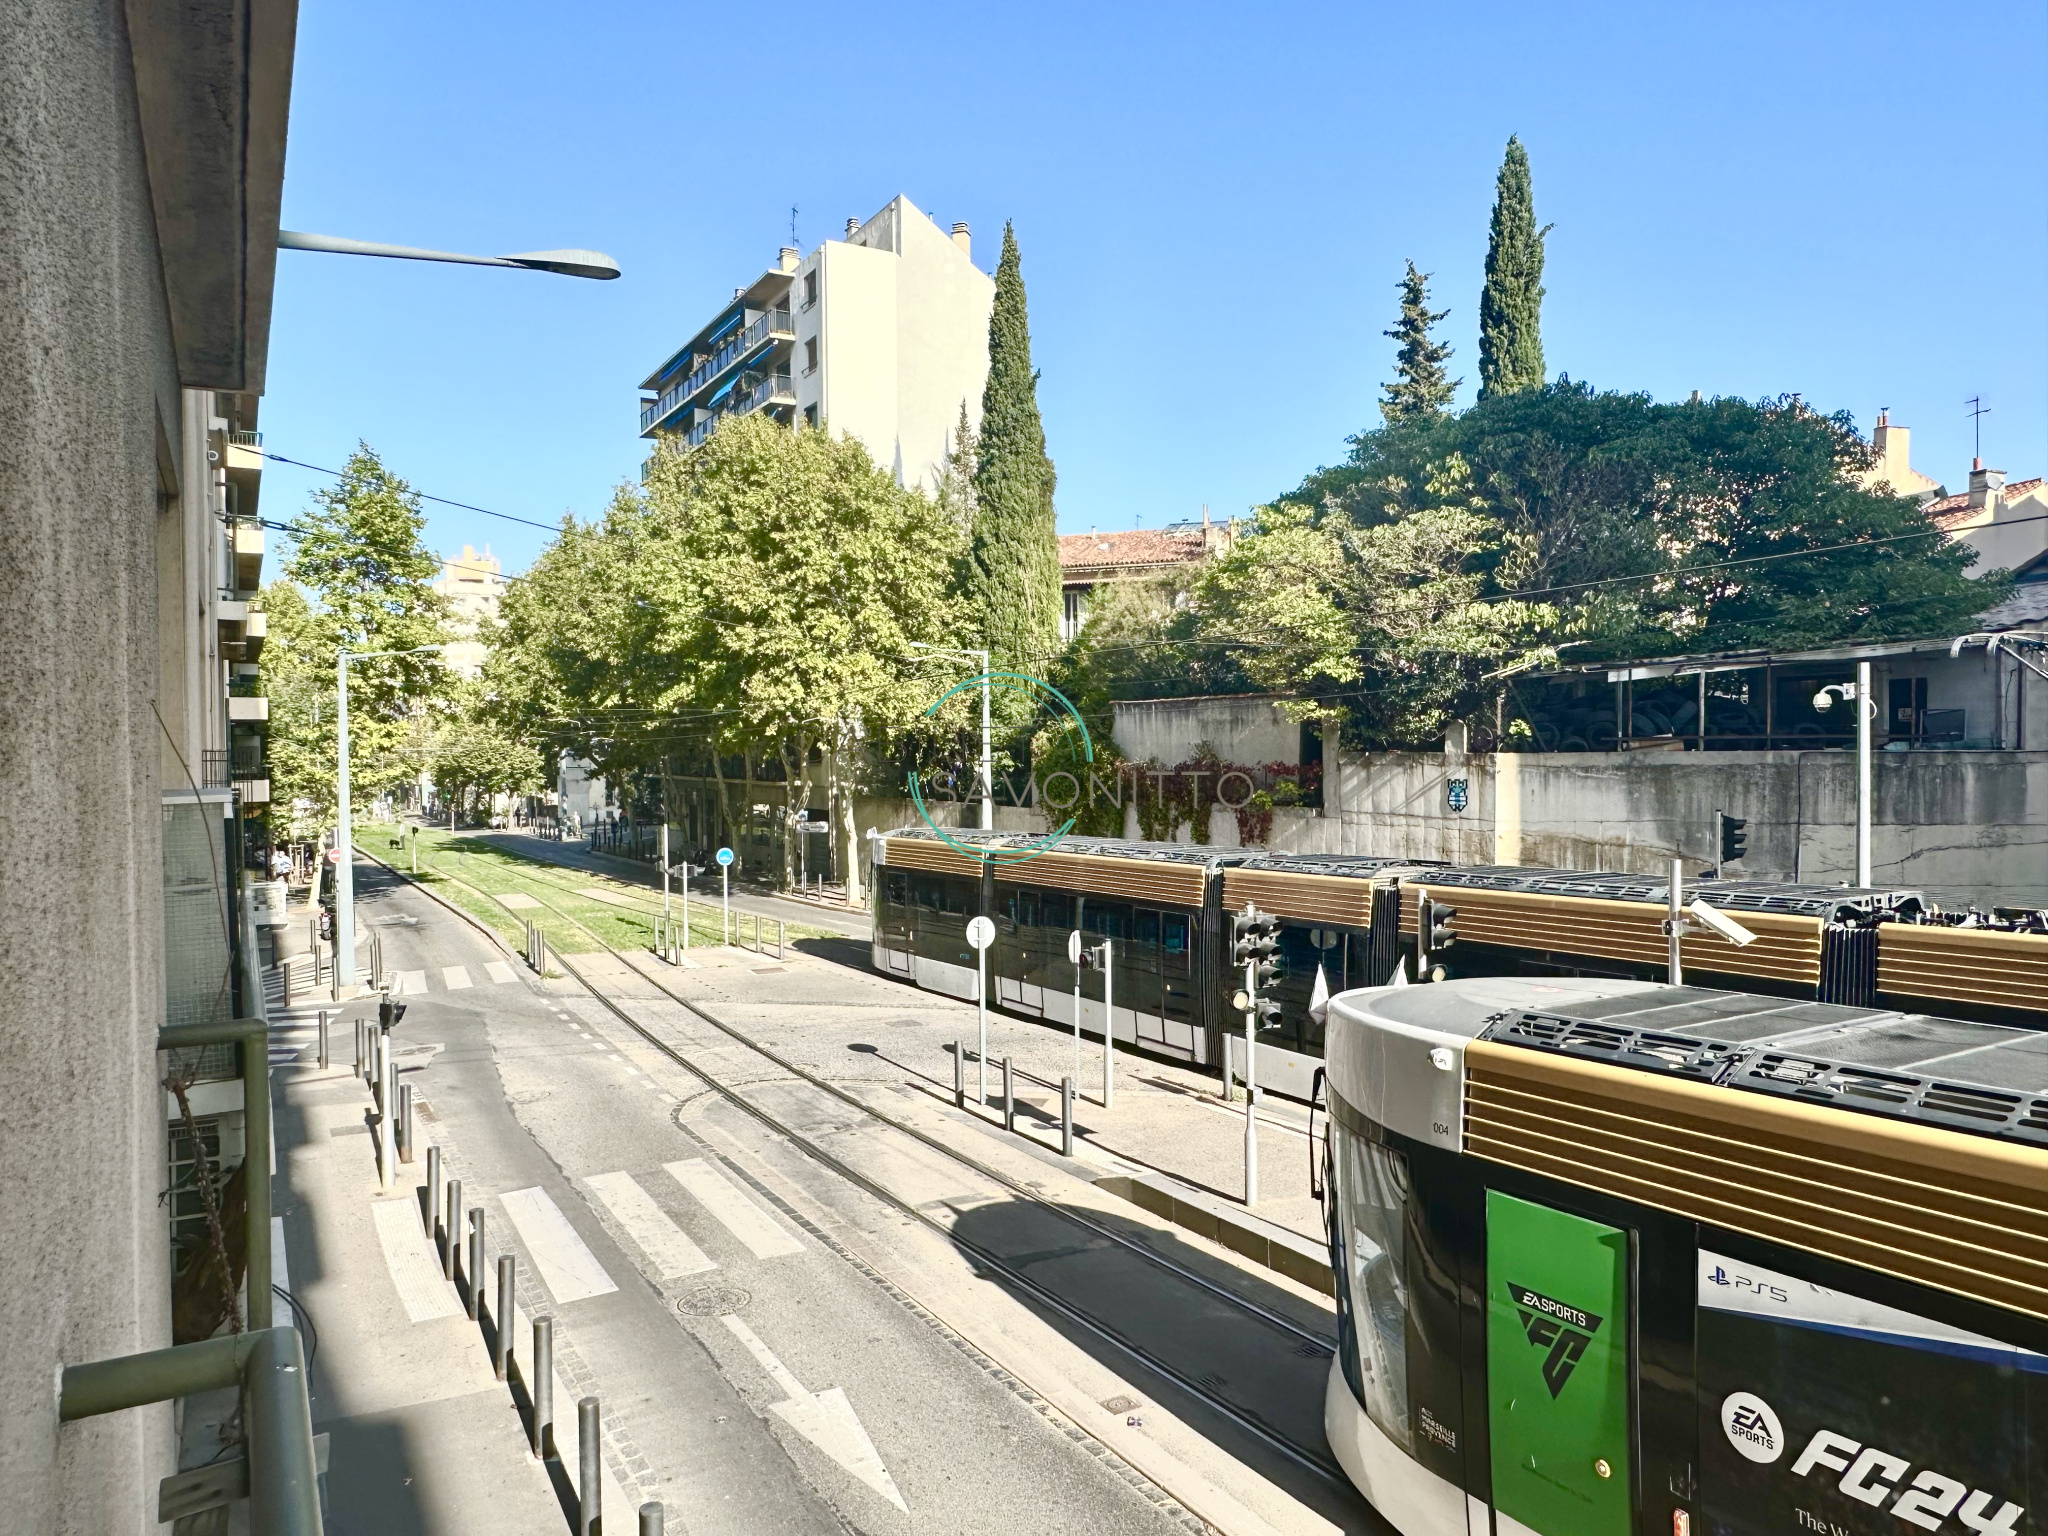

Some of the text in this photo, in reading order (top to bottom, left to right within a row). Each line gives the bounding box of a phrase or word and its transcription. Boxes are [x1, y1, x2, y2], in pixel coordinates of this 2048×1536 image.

[1433, 1122, 1449, 1136] 004
[1735, 1275, 1788, 1303] PS5
[1732, 1405, 1772, 1439] EA
[1731, 1424, 1774, 1450] SPORTS
[1795, 1507, 1827, 1535] The
